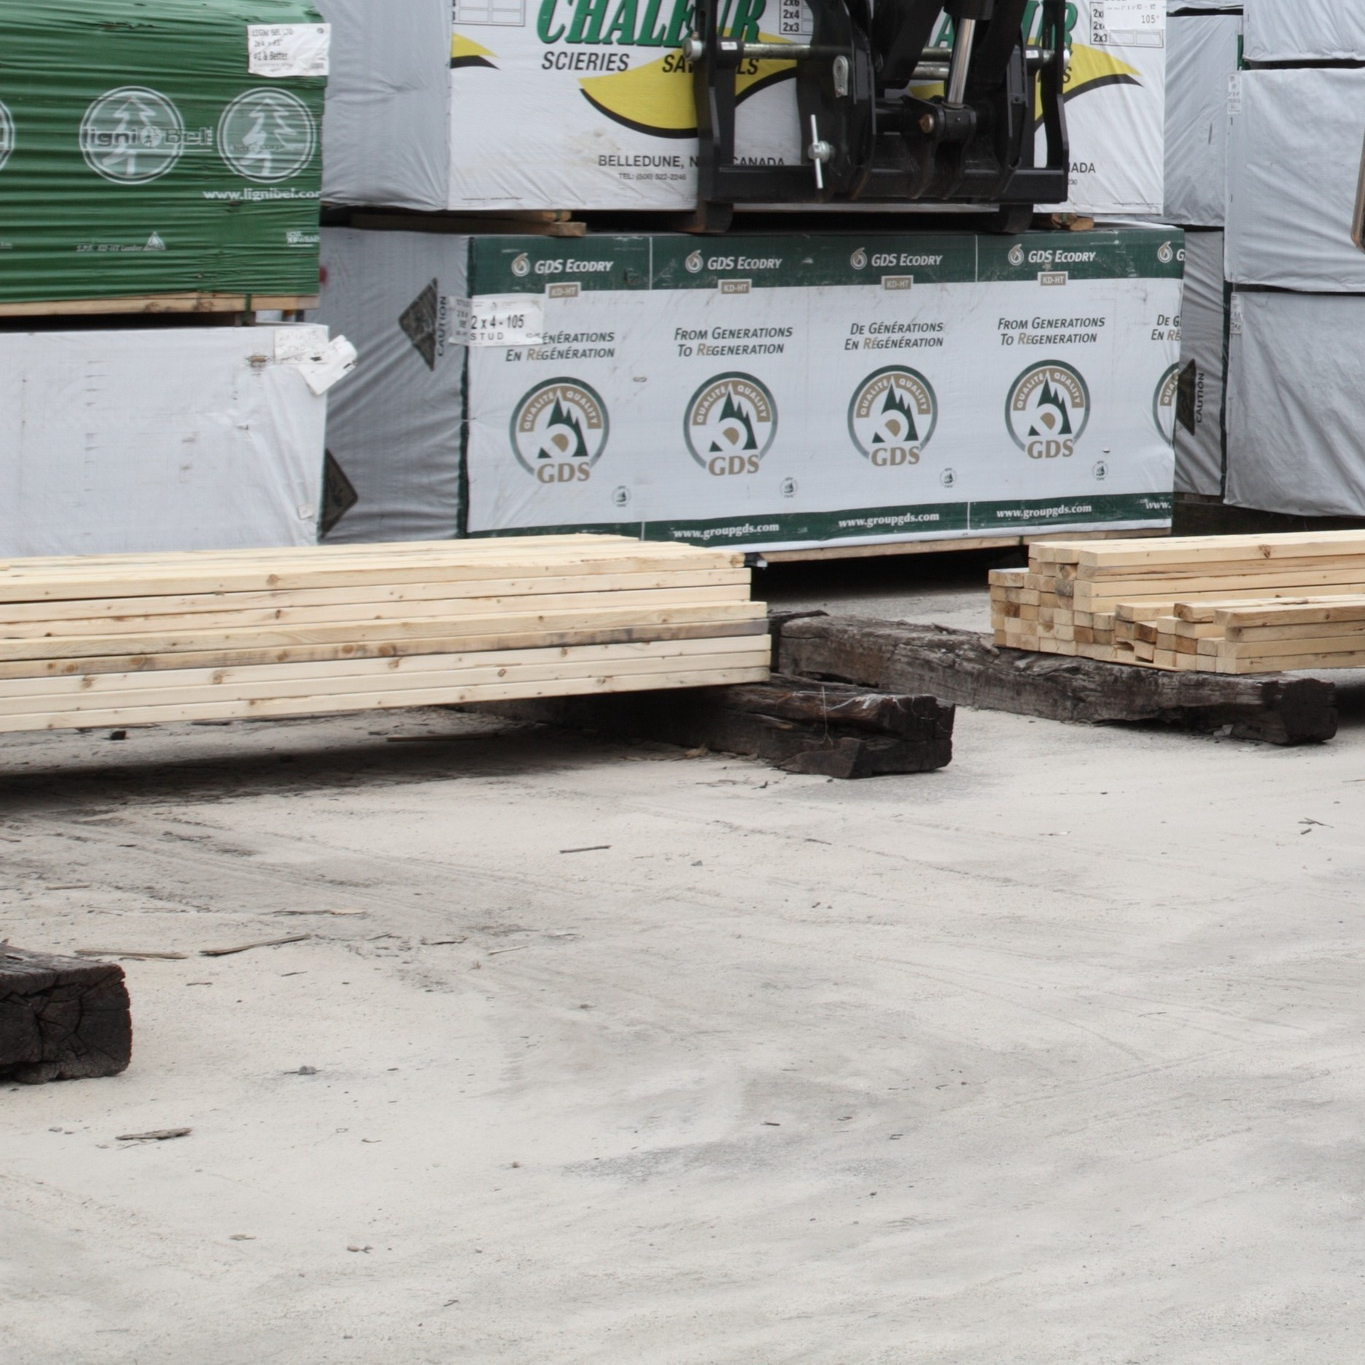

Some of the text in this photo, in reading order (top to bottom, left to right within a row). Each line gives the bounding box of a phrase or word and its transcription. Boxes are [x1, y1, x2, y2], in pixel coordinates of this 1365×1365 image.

[783, 9, 800, 19] 2x4
[783, 22, 800, 32] 2x3
[1093, 33, 1108, 43] 2x3
[541, 51, 630, 71] SCIERIES
[708, 257, 734, 270] GDS
[871, 254, 896, 266] GDS
[1028, 250, 1052, 263] GDS
[535, 260, 562, 274] GDS
[723, 284, 748, 293] KD-HT
[1042, 275, 1064, 285] KD-HT
[437, 295, 447, 358] CAUTION
[471, 314, 524, 329] 2 x 4 105
[471, 332, 504, 341] STUD
[542, 330, 615, 345] ÉNÉRATIONS
[899, 377, 927, 411] QUALITY
[1053, 371, 1081, 405] QUALITY
[566, 389, 598, 425] QUALITY
[737, 384, 768, 419] QUALITY
[1196, 373, 1205, 424] CAUTION
[871, 445, 920, 466] GDS
[1027, 439, 1074, 459] GDS
[537, 461, 591, 484] GDS
[708, 454, 760, 476] GDS
[996, 503, 1092, 519] www.groupgds.com
[838, 511, 940, 529] www.groupgds.com
[674, 522, 780, 540] www.groupgds.com
